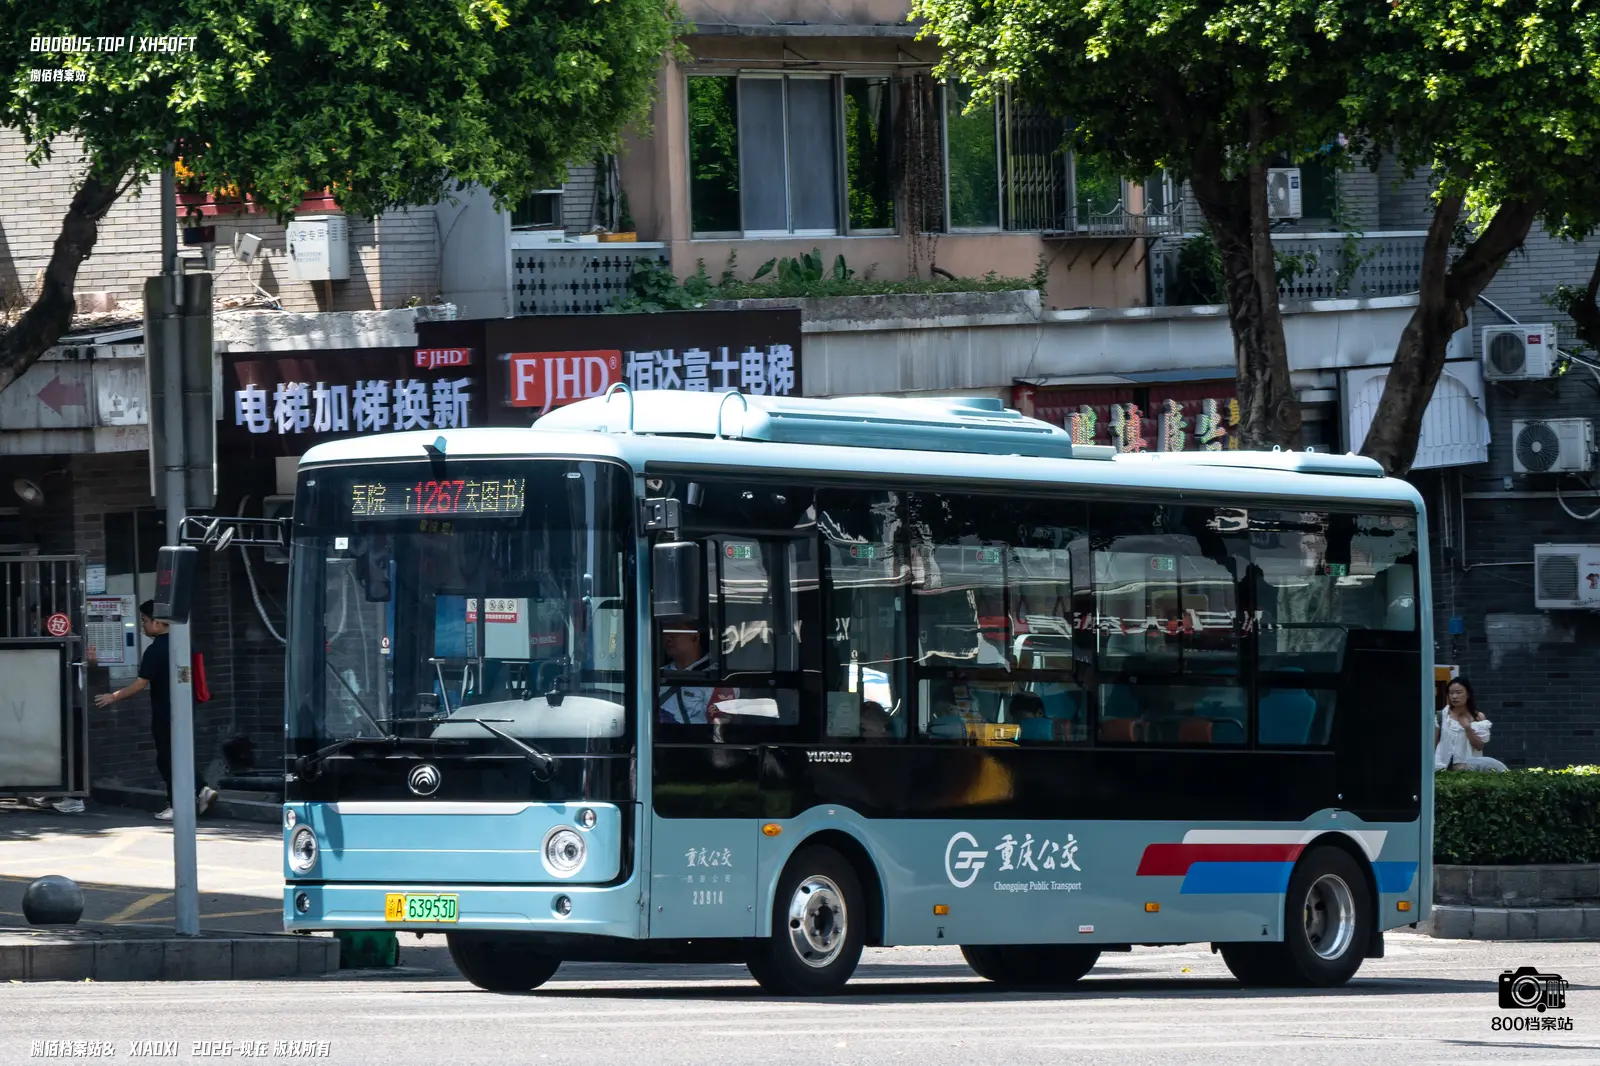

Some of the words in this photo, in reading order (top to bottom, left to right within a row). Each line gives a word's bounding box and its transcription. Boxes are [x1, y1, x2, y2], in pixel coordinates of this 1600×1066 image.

[289, 228, 325, 243] 公安专用
[626, 344, 796, 396] 恒达富士电梯
[234, 376, 473, 435] 电梯加梯换新
[414, 480, 465, 515] 1267
[51, 617, 67, 633] 拉
[805, 750, 853, 763] YUTONG
[685, 847, 733, 868] 重庆公交
[994, 833, 1082, 872] 重庆公交
[993, 880, 1029, 893] Chongqing
[1029, 880, 1049, 891] Public
[1050, 880, 1082, 893] Transport
[693, 890, 723, 906] 23914
